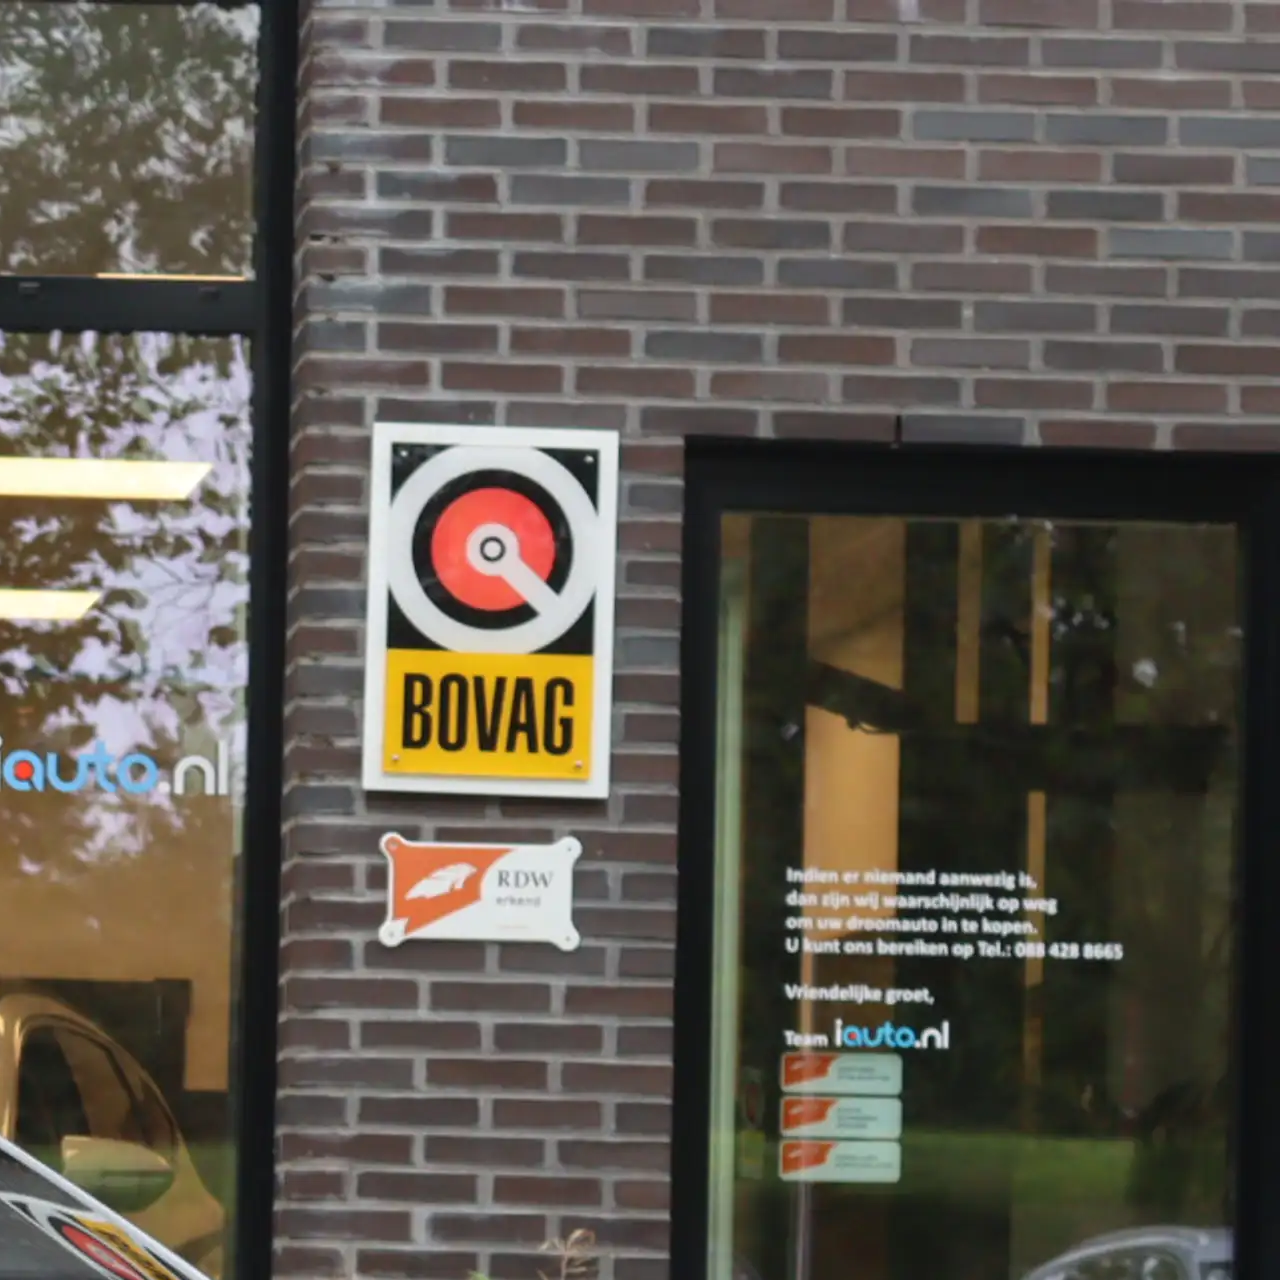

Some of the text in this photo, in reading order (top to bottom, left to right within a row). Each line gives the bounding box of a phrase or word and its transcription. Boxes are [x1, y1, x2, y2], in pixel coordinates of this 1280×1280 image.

[401, 673, 575, 756] BOVAG
[498, 869, 554, 888] RDW
[786, 867, 838, 883] Indien
[843, 871, 859, 884] er
[864, 869, 936, 885] niemand
[939, 870, 1015, 891] aanwezig
[786, 890, 1058, 915] dan zijn wij waarschijnlijk op weg
[785, 916, 1038, 936] om uw droomauto in te kopen.
[785, 938, 799, 953] U
[802, 938, 841, 953] kunt
[843, 941, 873, 954] ons
[877, 938, 948, 956] bereiken
[951, 942, 974, 960] op
[1049, 942, 1079, 959] 428
[1083, 943, 1124, 961] 8665
[784, 984, 935, 1005] Vriendelijke groet,
[783, 1018, 950, 1048] Team iauto.nl
